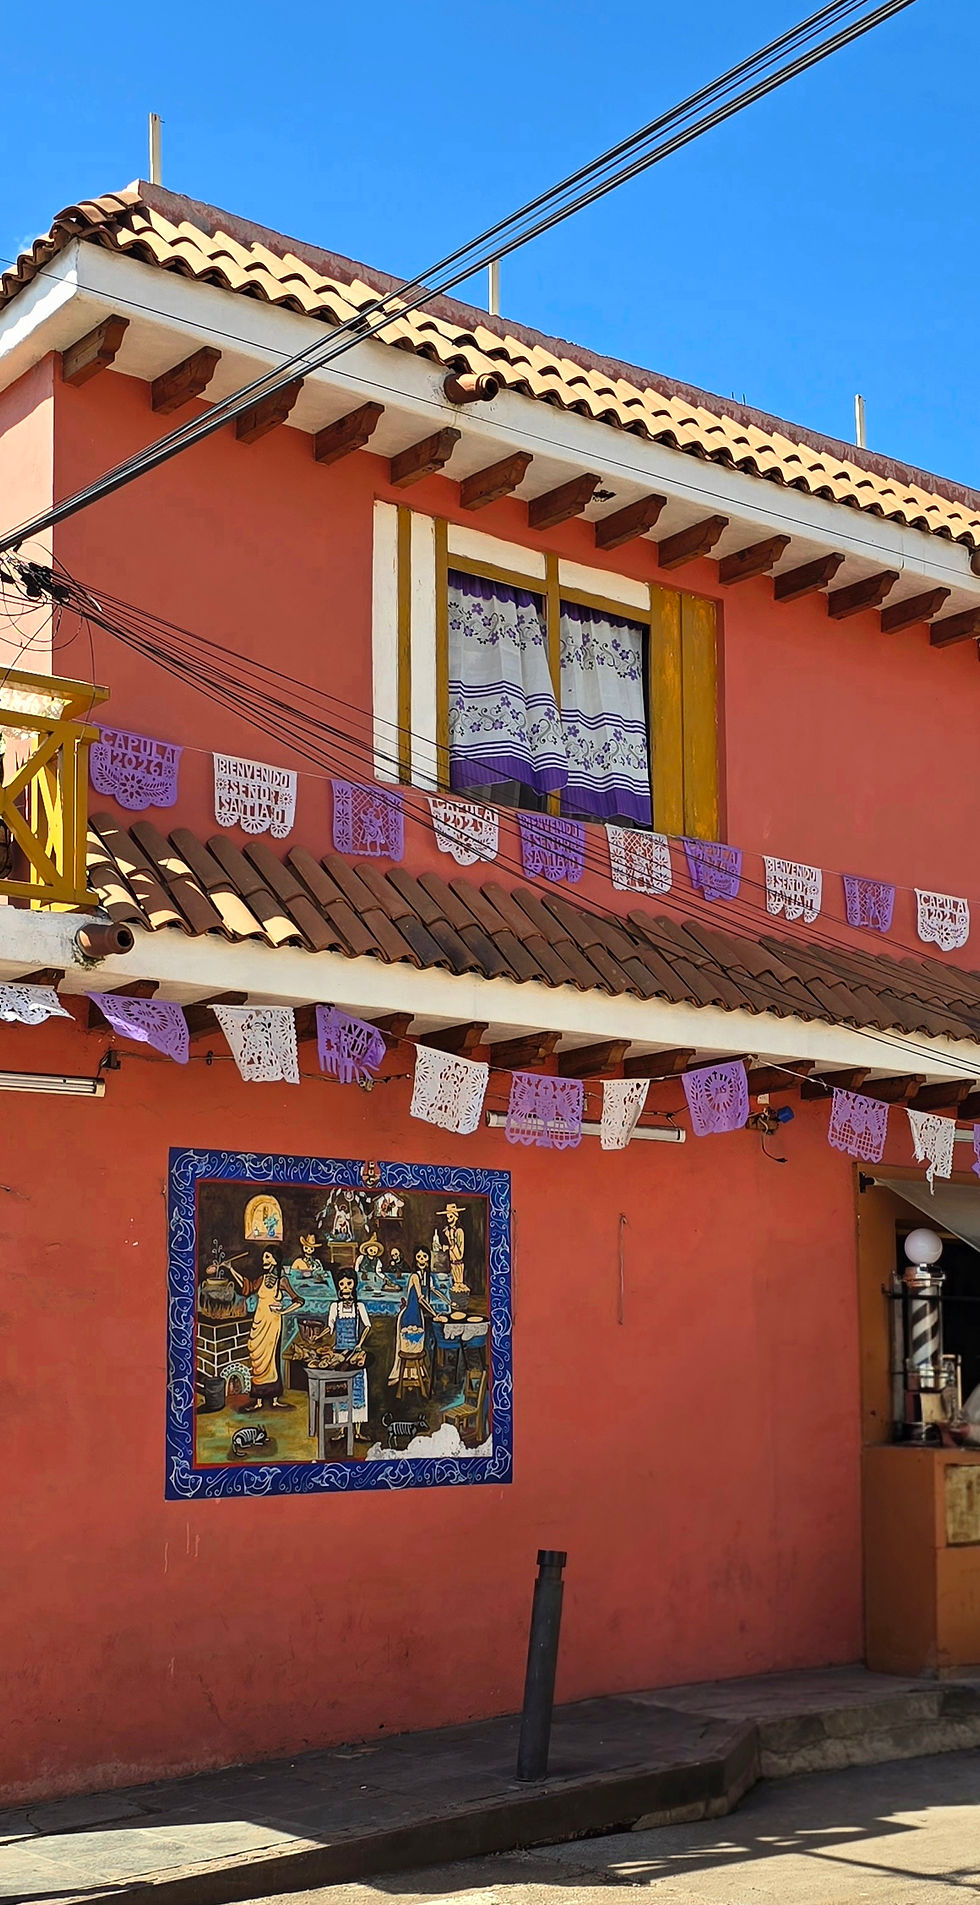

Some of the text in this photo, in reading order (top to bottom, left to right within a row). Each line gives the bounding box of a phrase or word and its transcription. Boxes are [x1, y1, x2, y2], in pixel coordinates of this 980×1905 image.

[101, 729, 175, 763] CAPULA
[110, 748, 163, 776] 2026
[218, 758, 289, 788] BIENVENIDO
[228, 779, 279, 805] SEÑOR
[920, 894, 965, 913] CAPULA
